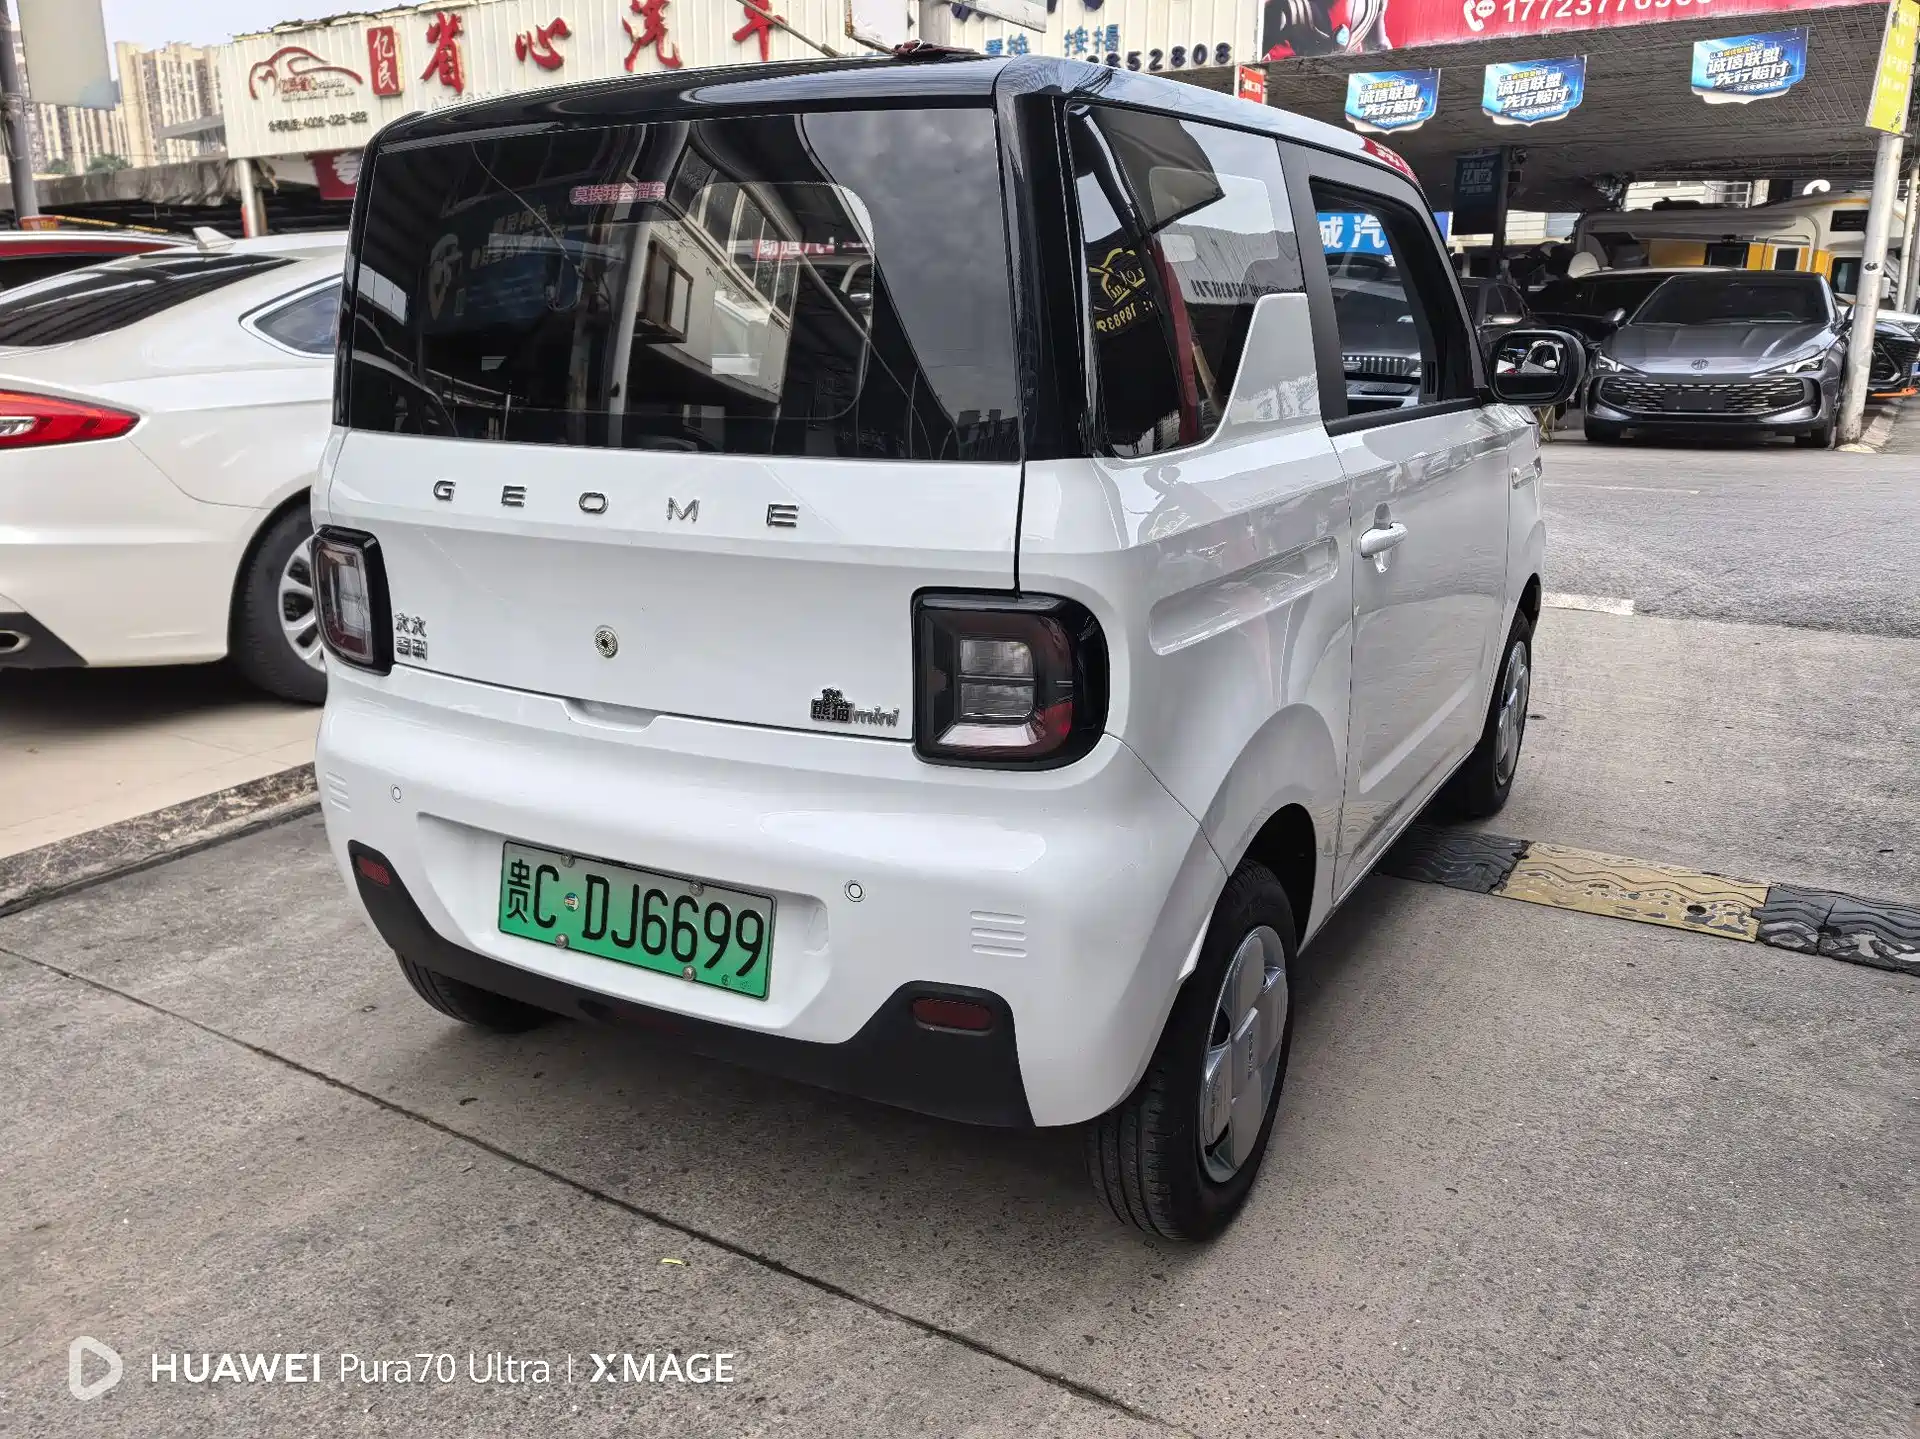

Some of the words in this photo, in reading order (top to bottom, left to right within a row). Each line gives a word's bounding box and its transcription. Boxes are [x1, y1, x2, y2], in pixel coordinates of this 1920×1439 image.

[1064, 24, 1119, 56] 按揭
[373, 31, 396, 90] 亿民
[1708, 46, 1780, 74] 诚信联盟
[1715, 60, 1790, 86] 先行赔付
[1359, 84, 1418, 104] 诚信联盟
[1498, 72, 1563, 97] 诚信联盟
[1503, 86, 1569, 109] 先行赔付
[1363, 97, 1425, 117] 先行赔付
[433, 480, 800, 528] GEOME
[582, 874, 765, 977] DJ6699
